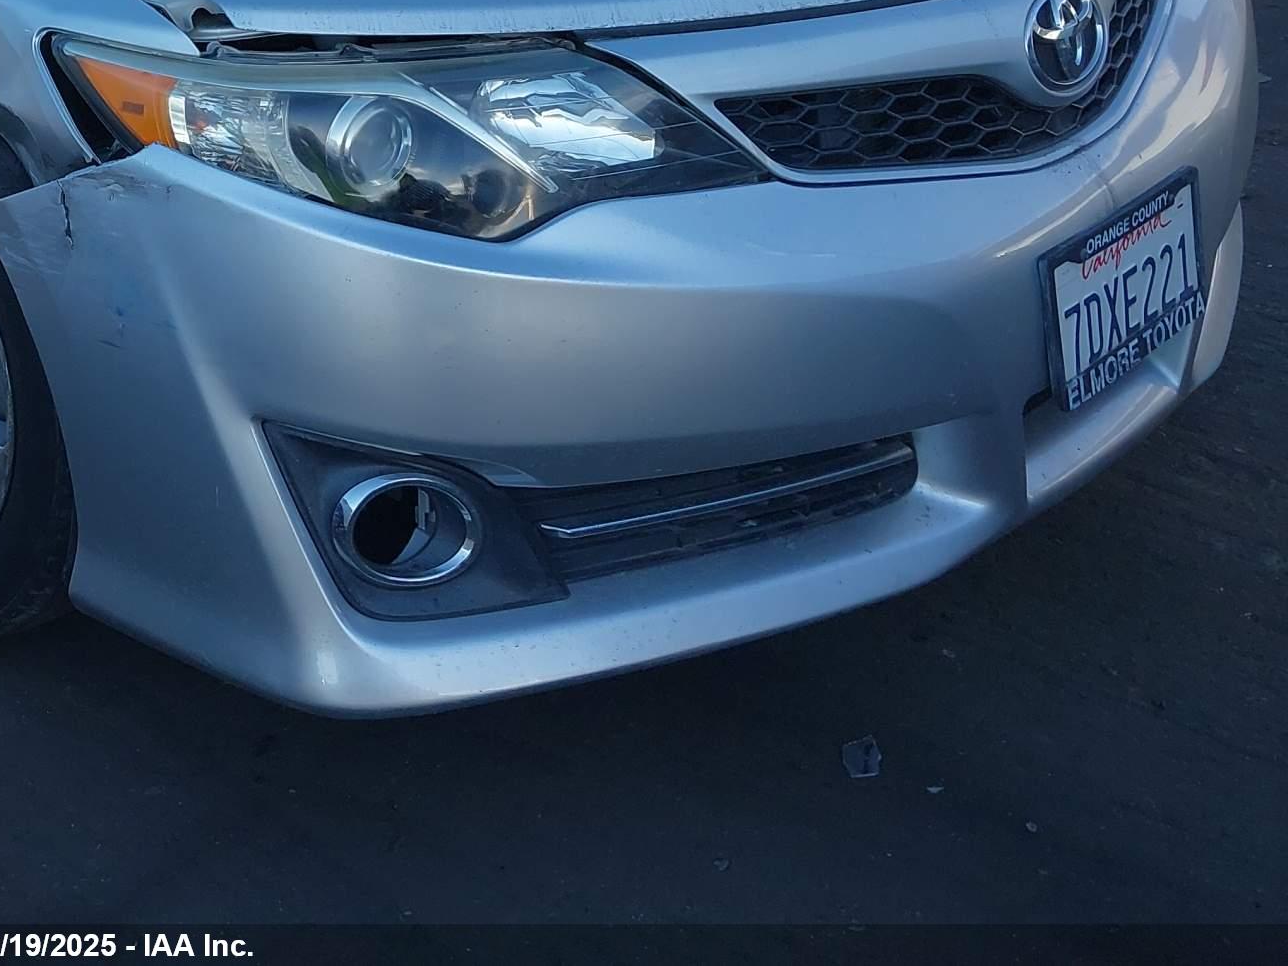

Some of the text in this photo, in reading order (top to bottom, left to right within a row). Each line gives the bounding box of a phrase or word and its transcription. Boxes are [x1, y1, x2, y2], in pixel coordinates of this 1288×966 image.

[1086, 189, 1170, 255] ORANGE COUNTY
[1064, 233, 1195, 379] 7DXE221
[1067, 291, 1205, 411] ELMORE TOYOTA
